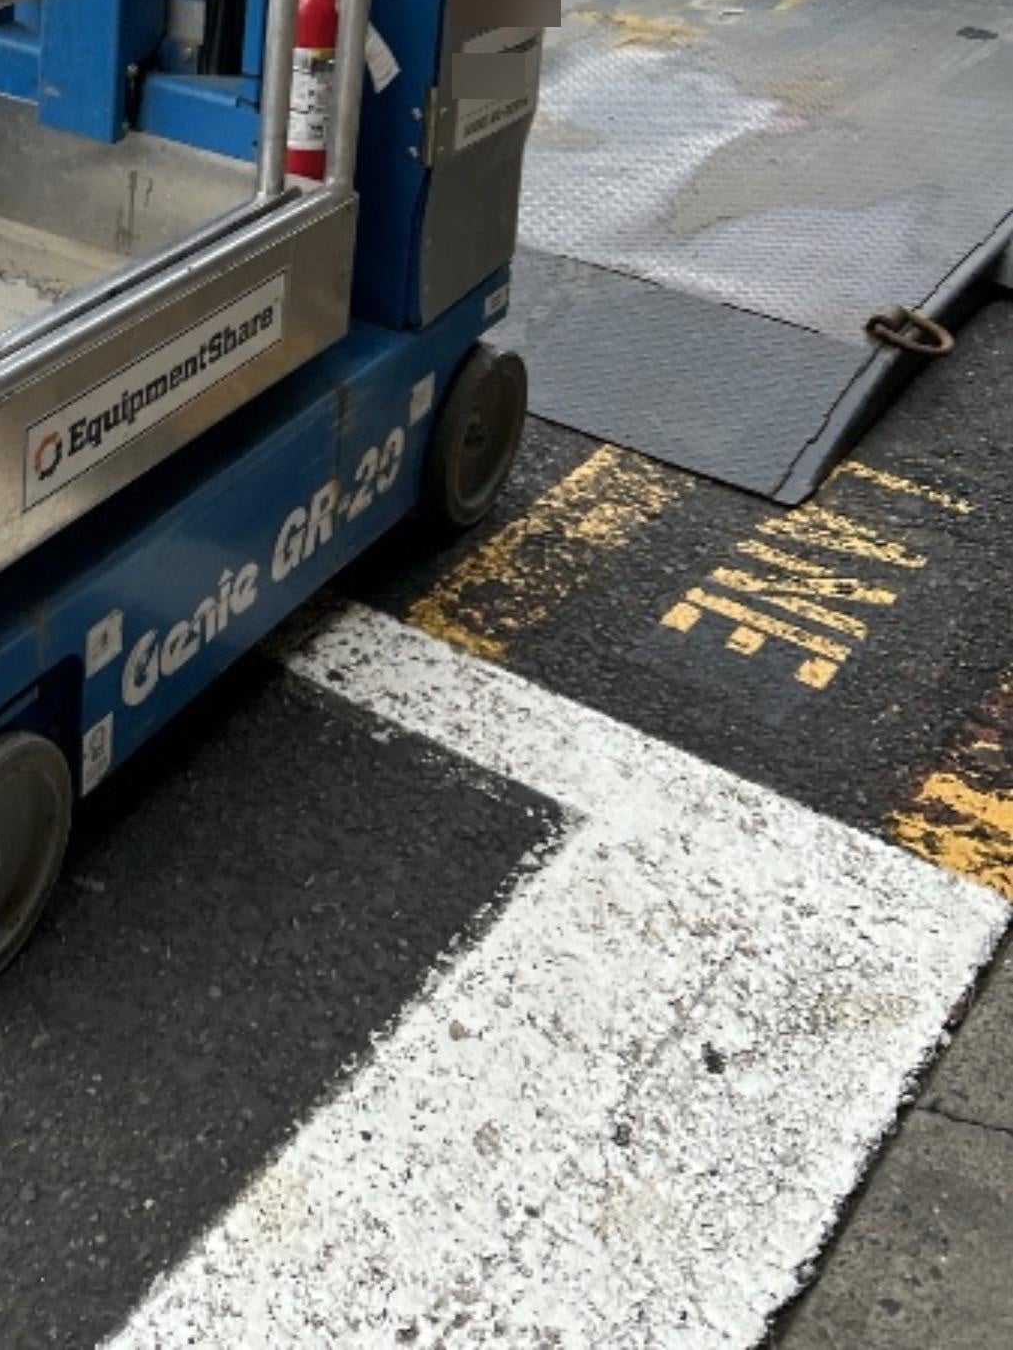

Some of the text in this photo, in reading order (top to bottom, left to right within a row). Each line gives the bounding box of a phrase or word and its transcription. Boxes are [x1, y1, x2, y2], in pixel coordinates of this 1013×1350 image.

[67, 305, 274, 457] EquipmentShare
[121, 425, 406, 707] Genie GR-20
[659, 460, 976, 690] LANE
